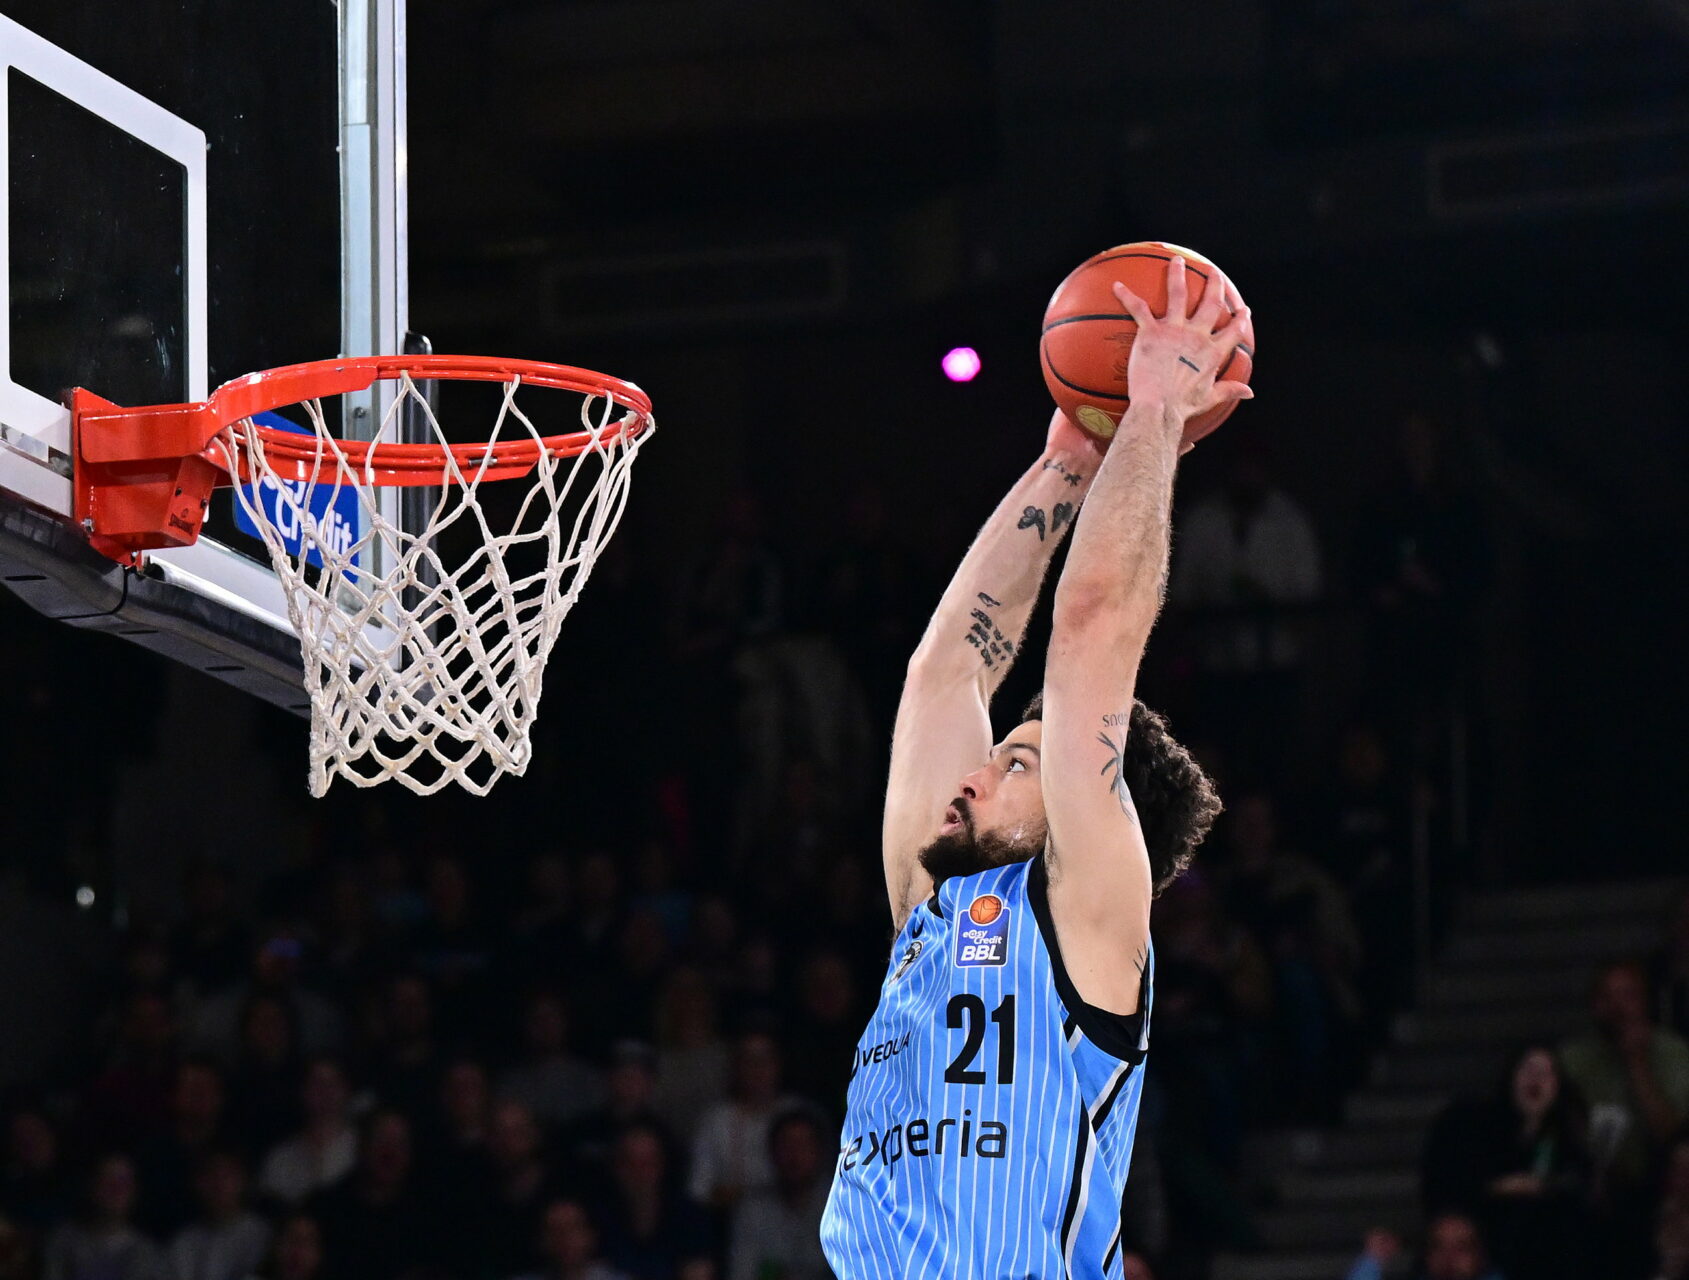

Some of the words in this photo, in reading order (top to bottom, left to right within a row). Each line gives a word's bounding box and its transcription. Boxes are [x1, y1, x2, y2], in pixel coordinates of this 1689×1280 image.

[961, 945, 1001, 961] BBL
[973, 935, 1003, 944] Credit
[944, 993, 1016, 1085] 21
[839, 1109, 1007, 1182] experia
